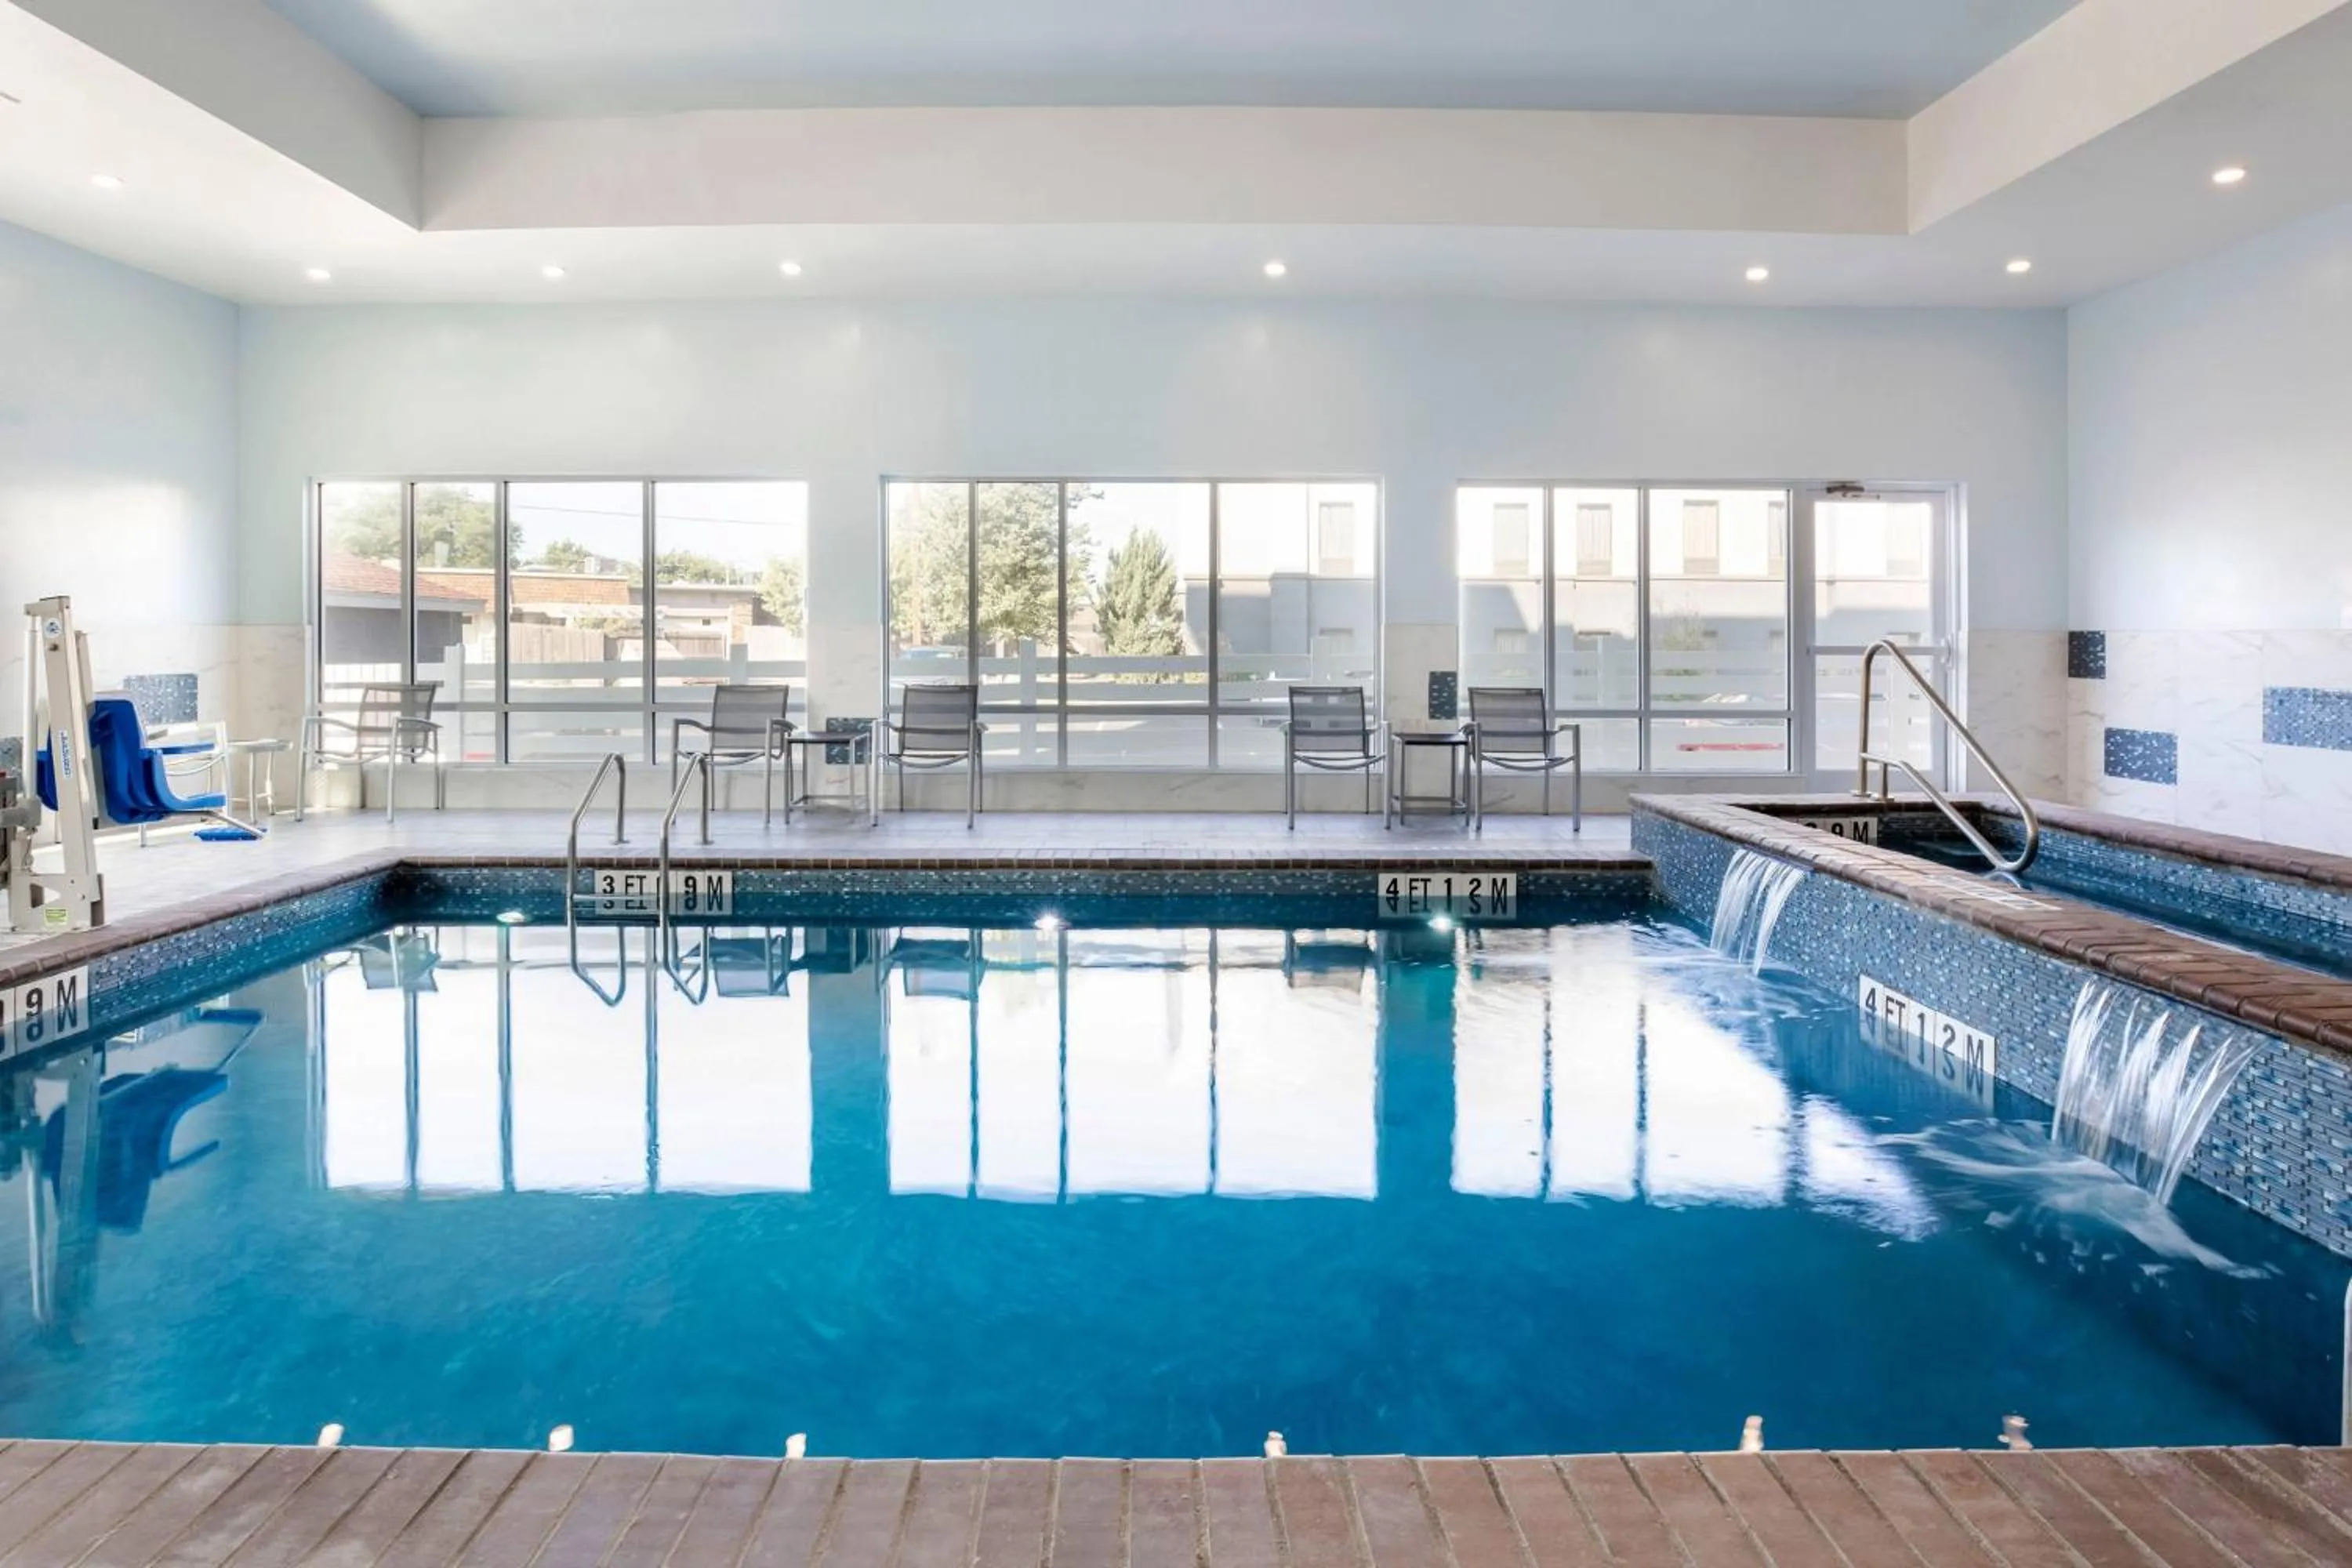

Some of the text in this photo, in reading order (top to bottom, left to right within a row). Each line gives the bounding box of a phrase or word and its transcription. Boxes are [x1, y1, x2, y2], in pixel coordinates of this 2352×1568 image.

[1853, 821, 1868, 844] M
[602, 875, 615, 894] 3
[625, 875, 647, 896] FT
[684, 875, 697, 895] 9
[707, 875, 723, 895] M
[1386, 877, 1399, 896] 4
[1409, 878, 1432, 897] FT
[1492, 877, 1507, 897] M
[26, 987, 43, 1017] 9
[57, 975, 76, 1008] M
[1865, 987, 1877, 1013] 4
[1886, 995, 1906, 1029] FT
[1967, 1034, 1984, 1071] M
